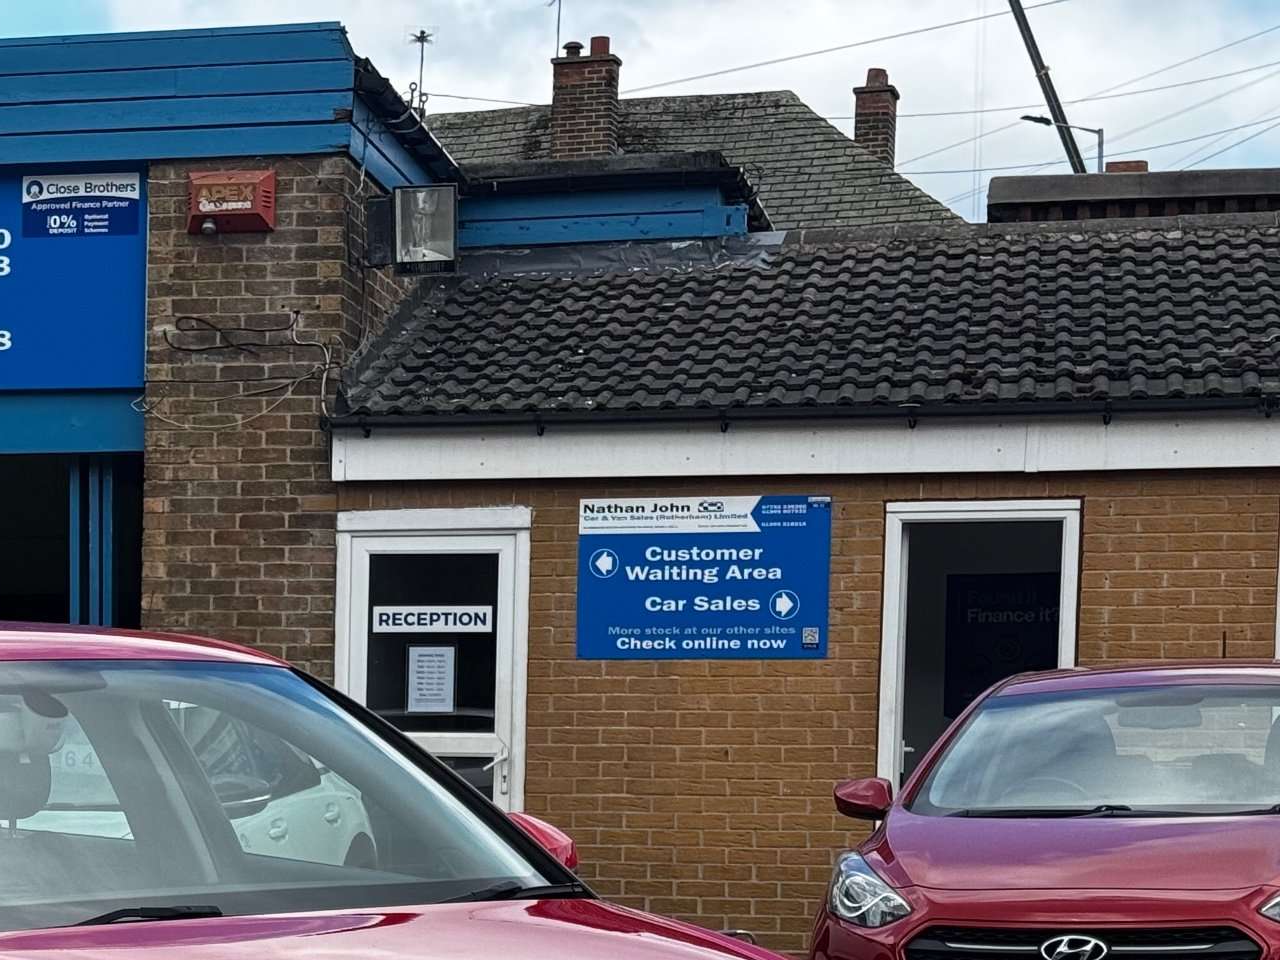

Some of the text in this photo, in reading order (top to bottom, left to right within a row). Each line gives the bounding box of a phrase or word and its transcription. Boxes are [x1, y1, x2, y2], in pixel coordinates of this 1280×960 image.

[46, 181, 137, 195] Close Brothers
[199, 185, 254, 201] APEX
[31, 200, 129, 211] Approved Finance Partner
[50, 214, 77, 228] 0%
[584, 503, 690, 513] Nathan John
[646, 547, 763, 561] Customer
[626, 565, 781, 583] Waiting Area
[645, 596, 760, 611] Car Sales
[379, 613, 486, 626] RECEPTION
[967, 608, 1036, 623] Finance
[726, 626, 760, 634] other
[764, 625, 796, 634] sites
[617, 637, 786, 649] Check online now
